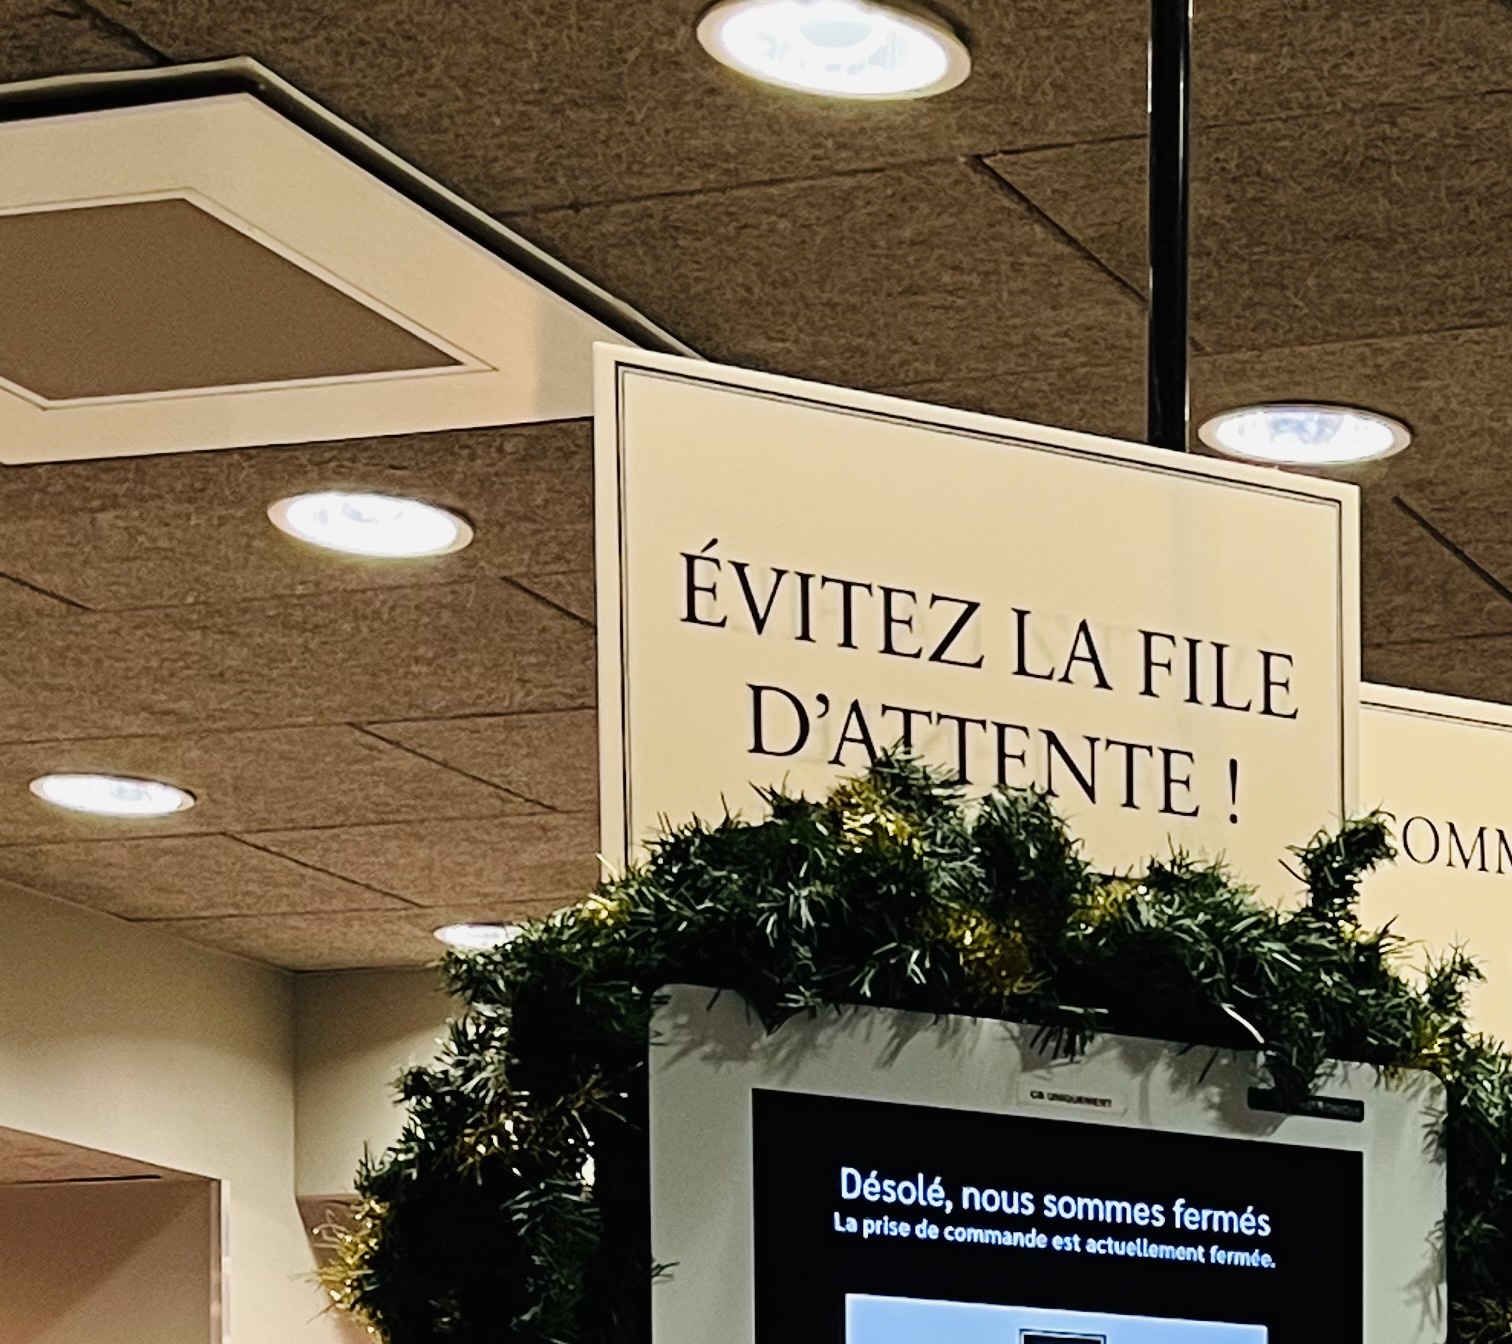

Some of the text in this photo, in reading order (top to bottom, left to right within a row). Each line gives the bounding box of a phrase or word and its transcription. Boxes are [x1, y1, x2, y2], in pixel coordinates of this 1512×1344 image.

[680, 538, 1299, 720] ÉVITEZ LA FILE
[840, 1166, 1272, 1237] Désolé, nous sommes fermés
[833, 1211, 1277, 1269] La prise de commande est actuellement fermée.
